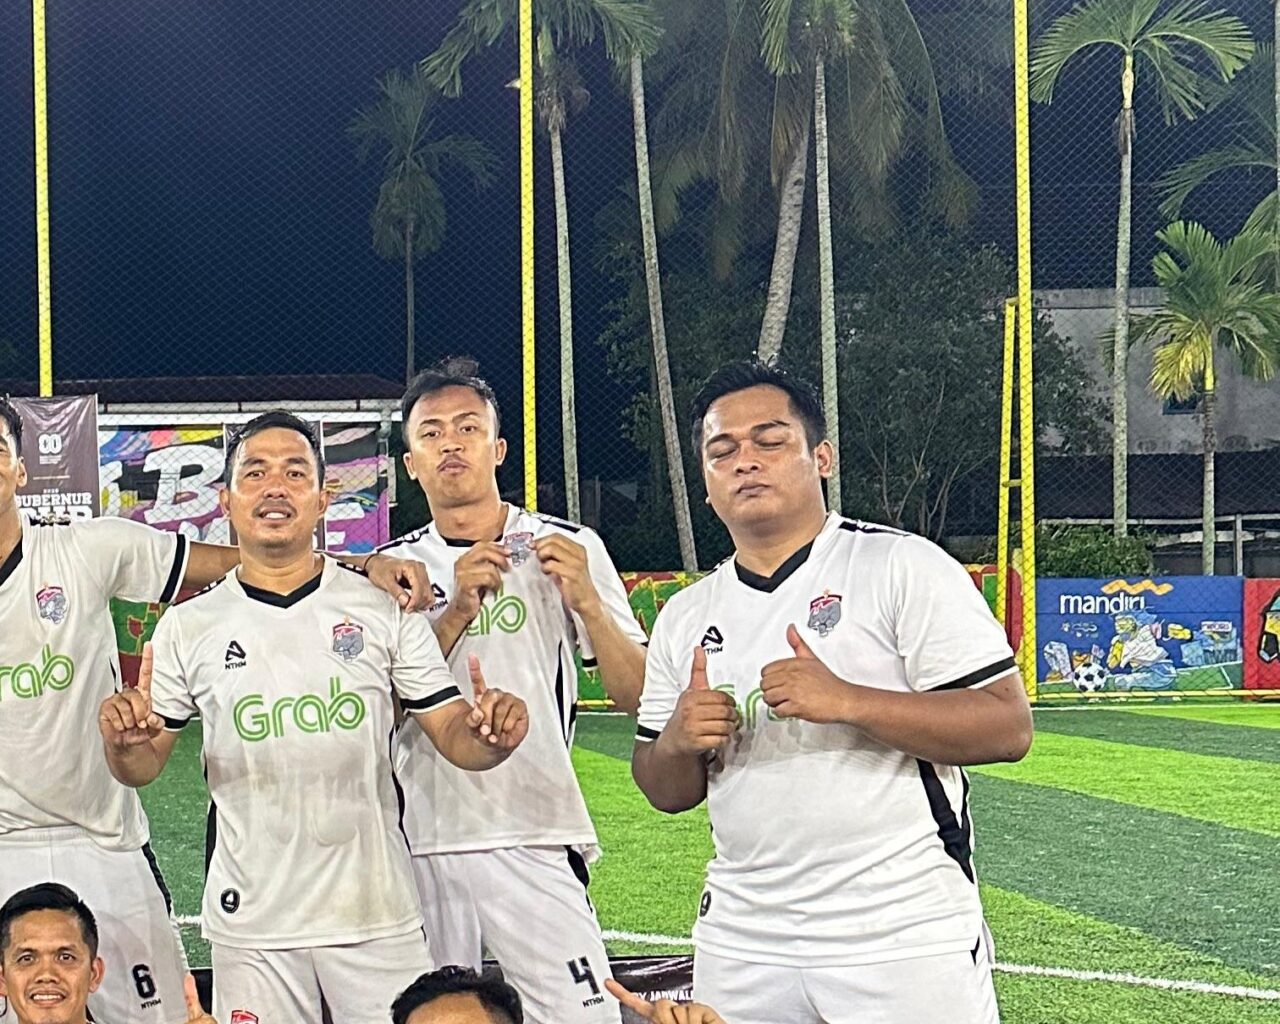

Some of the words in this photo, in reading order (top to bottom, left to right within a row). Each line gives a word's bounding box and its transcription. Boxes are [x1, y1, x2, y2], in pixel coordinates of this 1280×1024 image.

[1059, 592, 1145, 614] mandiri
[703, 646, 723, 655] THM
[233, 676, 366, 742] Grab
[132, 963, 157, 999] 6
[566, 955, 600, 995] 4
